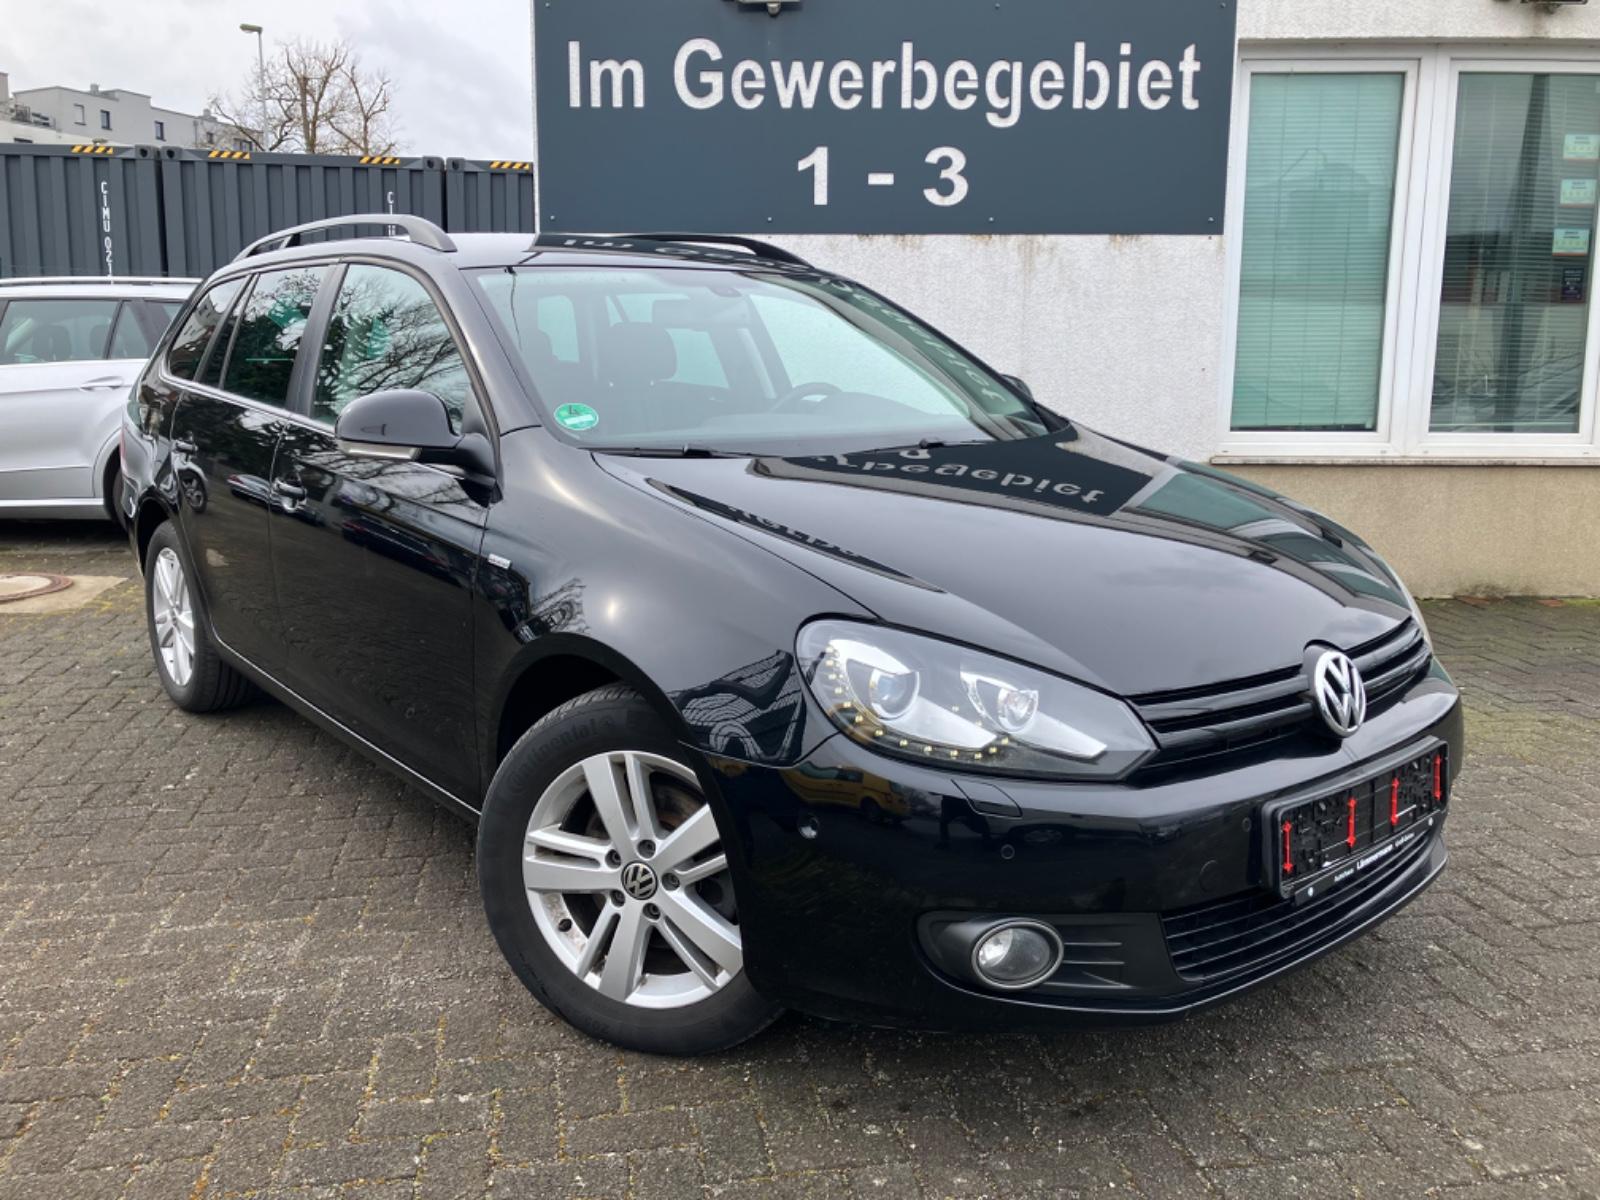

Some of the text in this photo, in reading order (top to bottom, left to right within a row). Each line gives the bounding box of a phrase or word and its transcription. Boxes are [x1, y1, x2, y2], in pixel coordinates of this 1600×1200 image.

[568, 38, 1201, 128] Im Gewerbegebiet
[797, 146, 969, 207] 1 - 3
